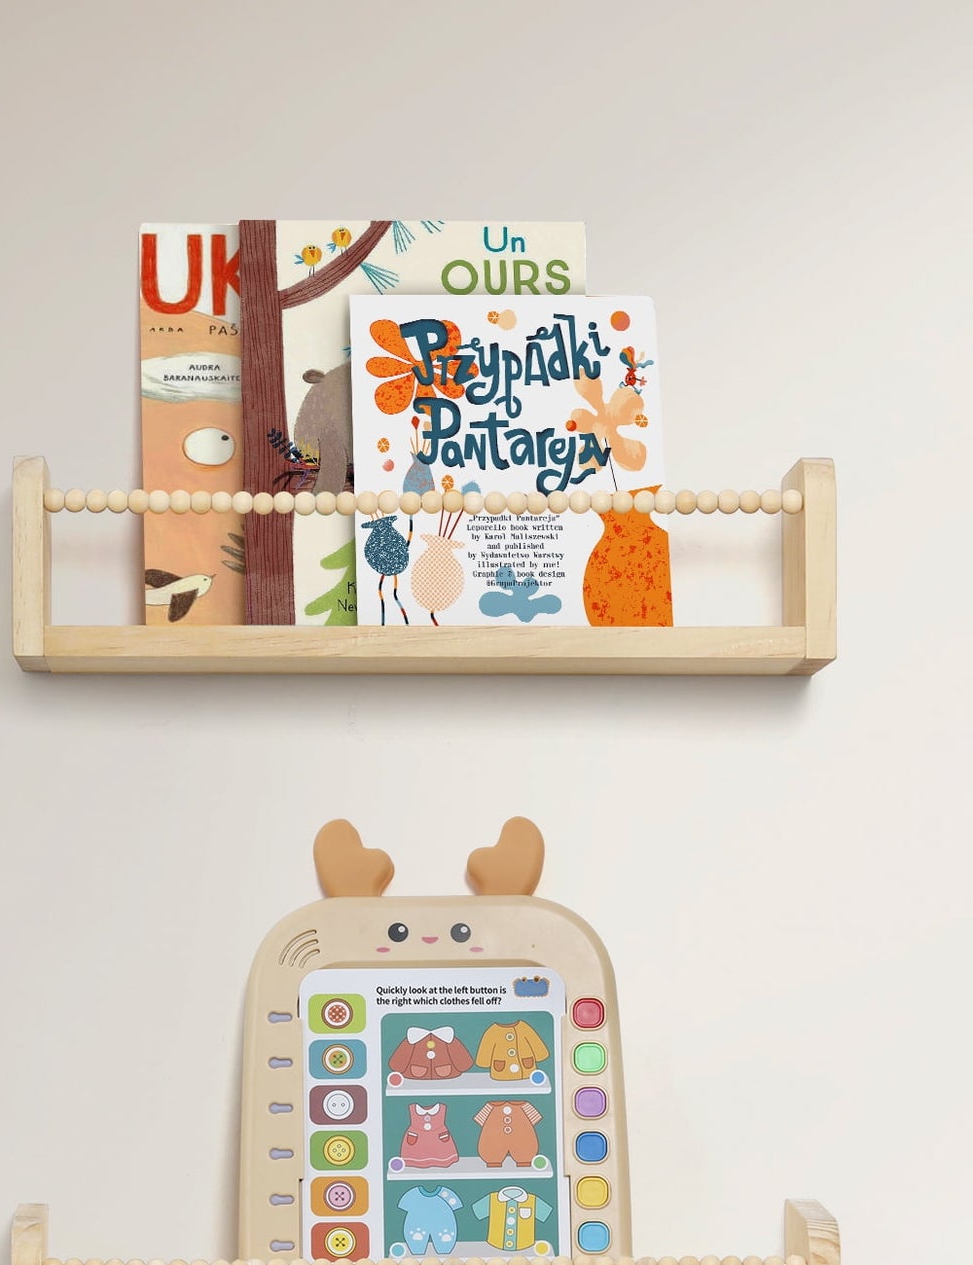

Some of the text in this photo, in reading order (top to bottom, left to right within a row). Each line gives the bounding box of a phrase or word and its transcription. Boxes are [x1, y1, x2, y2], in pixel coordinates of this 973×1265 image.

[483, 226, 526, 253] Un
[441, 259, 571, 295] OURS
[188, 364, 221, 372] AUDRA
[471, 533, 480, 541] by
[468, 552, 476, 560] by
[529, 561, 538, 569] by
[376, 986, 507, 996] Quickly look at the left button is
[376, 996, 502, 1007] the right which clothes fell off?
